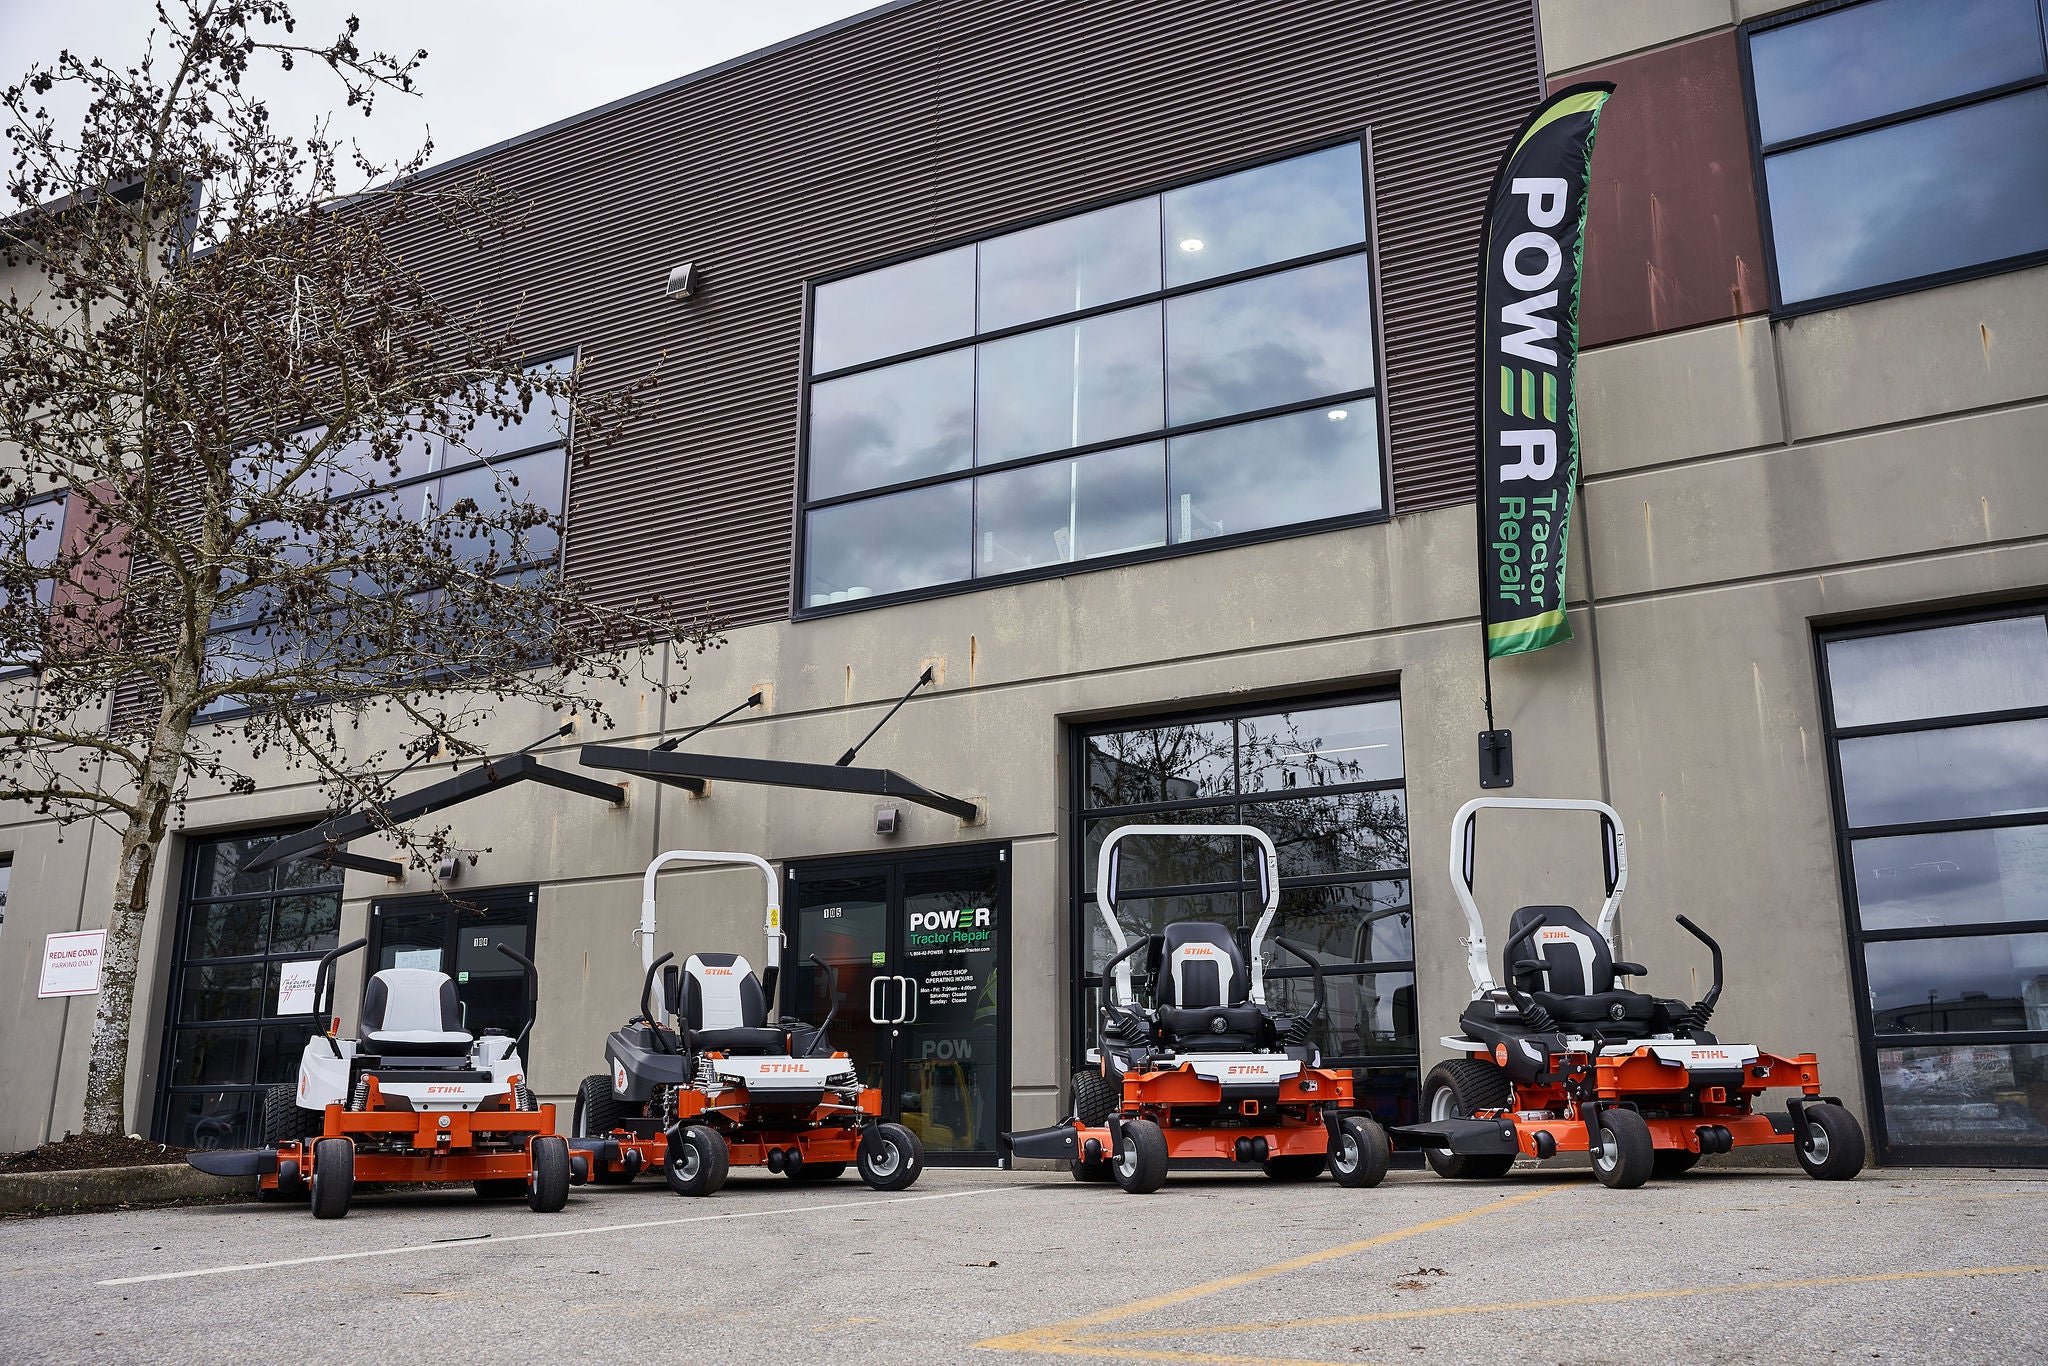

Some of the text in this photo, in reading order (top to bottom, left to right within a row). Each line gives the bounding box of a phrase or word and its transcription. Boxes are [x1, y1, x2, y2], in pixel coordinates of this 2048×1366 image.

[1499, 177, 1568, 484] POWER
[1492, 496, 1527, 606] Repair
[1530, 488, 1558, 608] Tractor
[823, 907, 842, 919] 105
[910, 908, 990, 931] POWER
[910, 929, 991, 945] Tractor Repair
[1543, 931, 1570, 939] STIHL
[49, 948, 99, 960] REDLINE COND.
[1184, 947, 1213, 955] STIHL
[51, 959, 93, 969] PARKING ONLY
[705, 968, 733, 976] STIHL
[930, 968, 968, 977] SERVICE SHOP
[925, 976, 955, 984] OPERATING
[1691, 1050, 1729, 1059] STIHL
[760, 1063, 810, 1073] STIHL
[1228, 1065, 1269, 1074] STIHL
